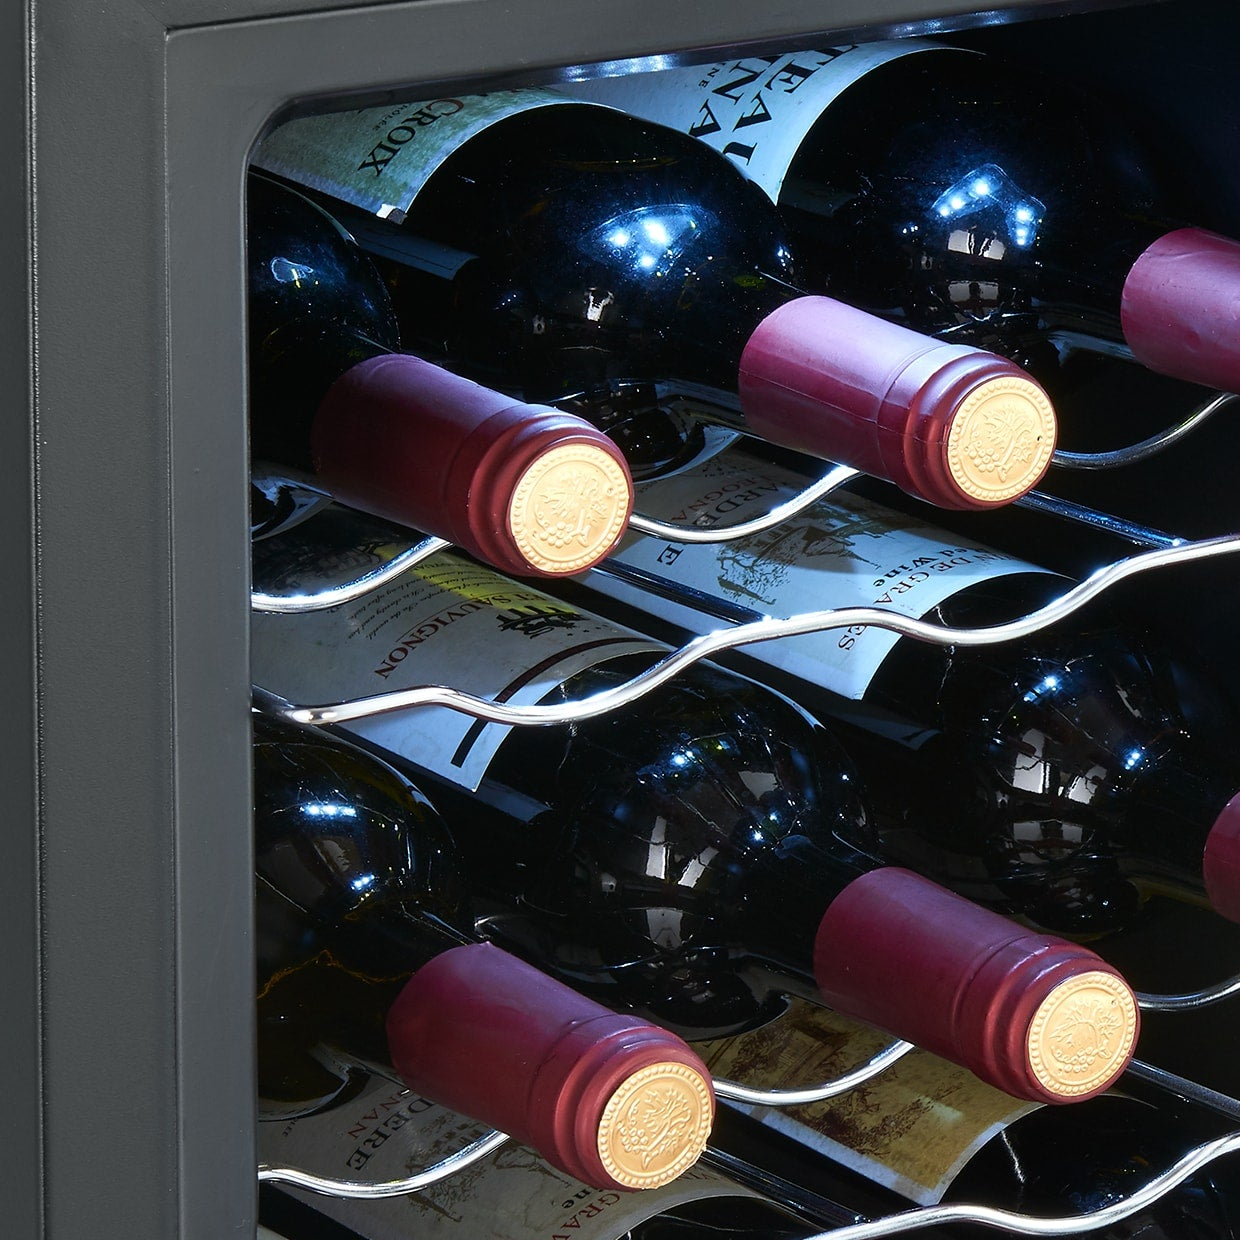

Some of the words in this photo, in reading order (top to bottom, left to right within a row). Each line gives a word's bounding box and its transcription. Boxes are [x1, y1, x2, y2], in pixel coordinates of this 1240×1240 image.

[357, 98, 465, 177] CROIX
[872, 555, 940, 587] Wine
[930, 556, 972, 572] DE
[374, 594, 512, 680] SAUVIGNON
